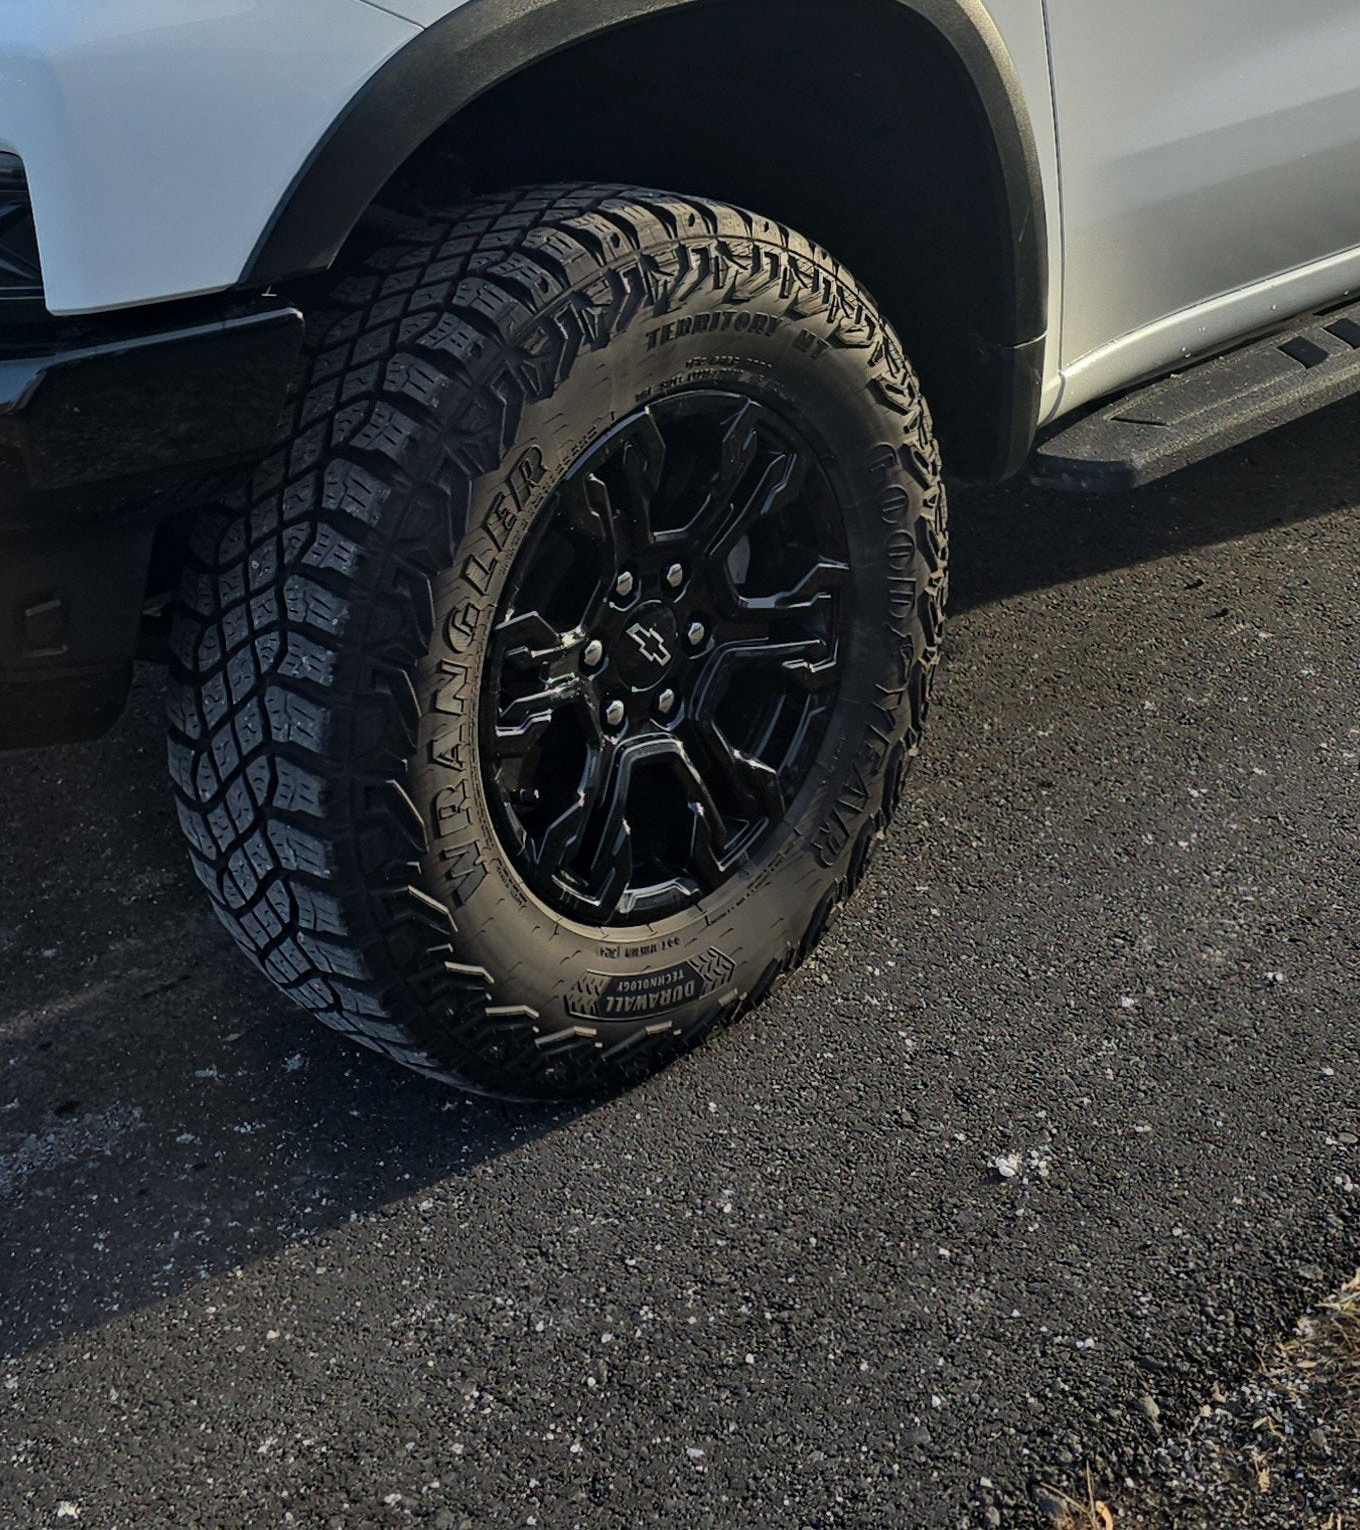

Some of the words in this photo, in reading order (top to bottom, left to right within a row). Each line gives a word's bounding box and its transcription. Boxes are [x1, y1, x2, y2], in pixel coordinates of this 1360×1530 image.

[645, 310, 784, 351] TERRITORY
[431, 444, 546, 906] WRANGLER
[605, 979, 696, 1013] DURAWALL
[617, 969, 684, 992] TECHNOLOGY
